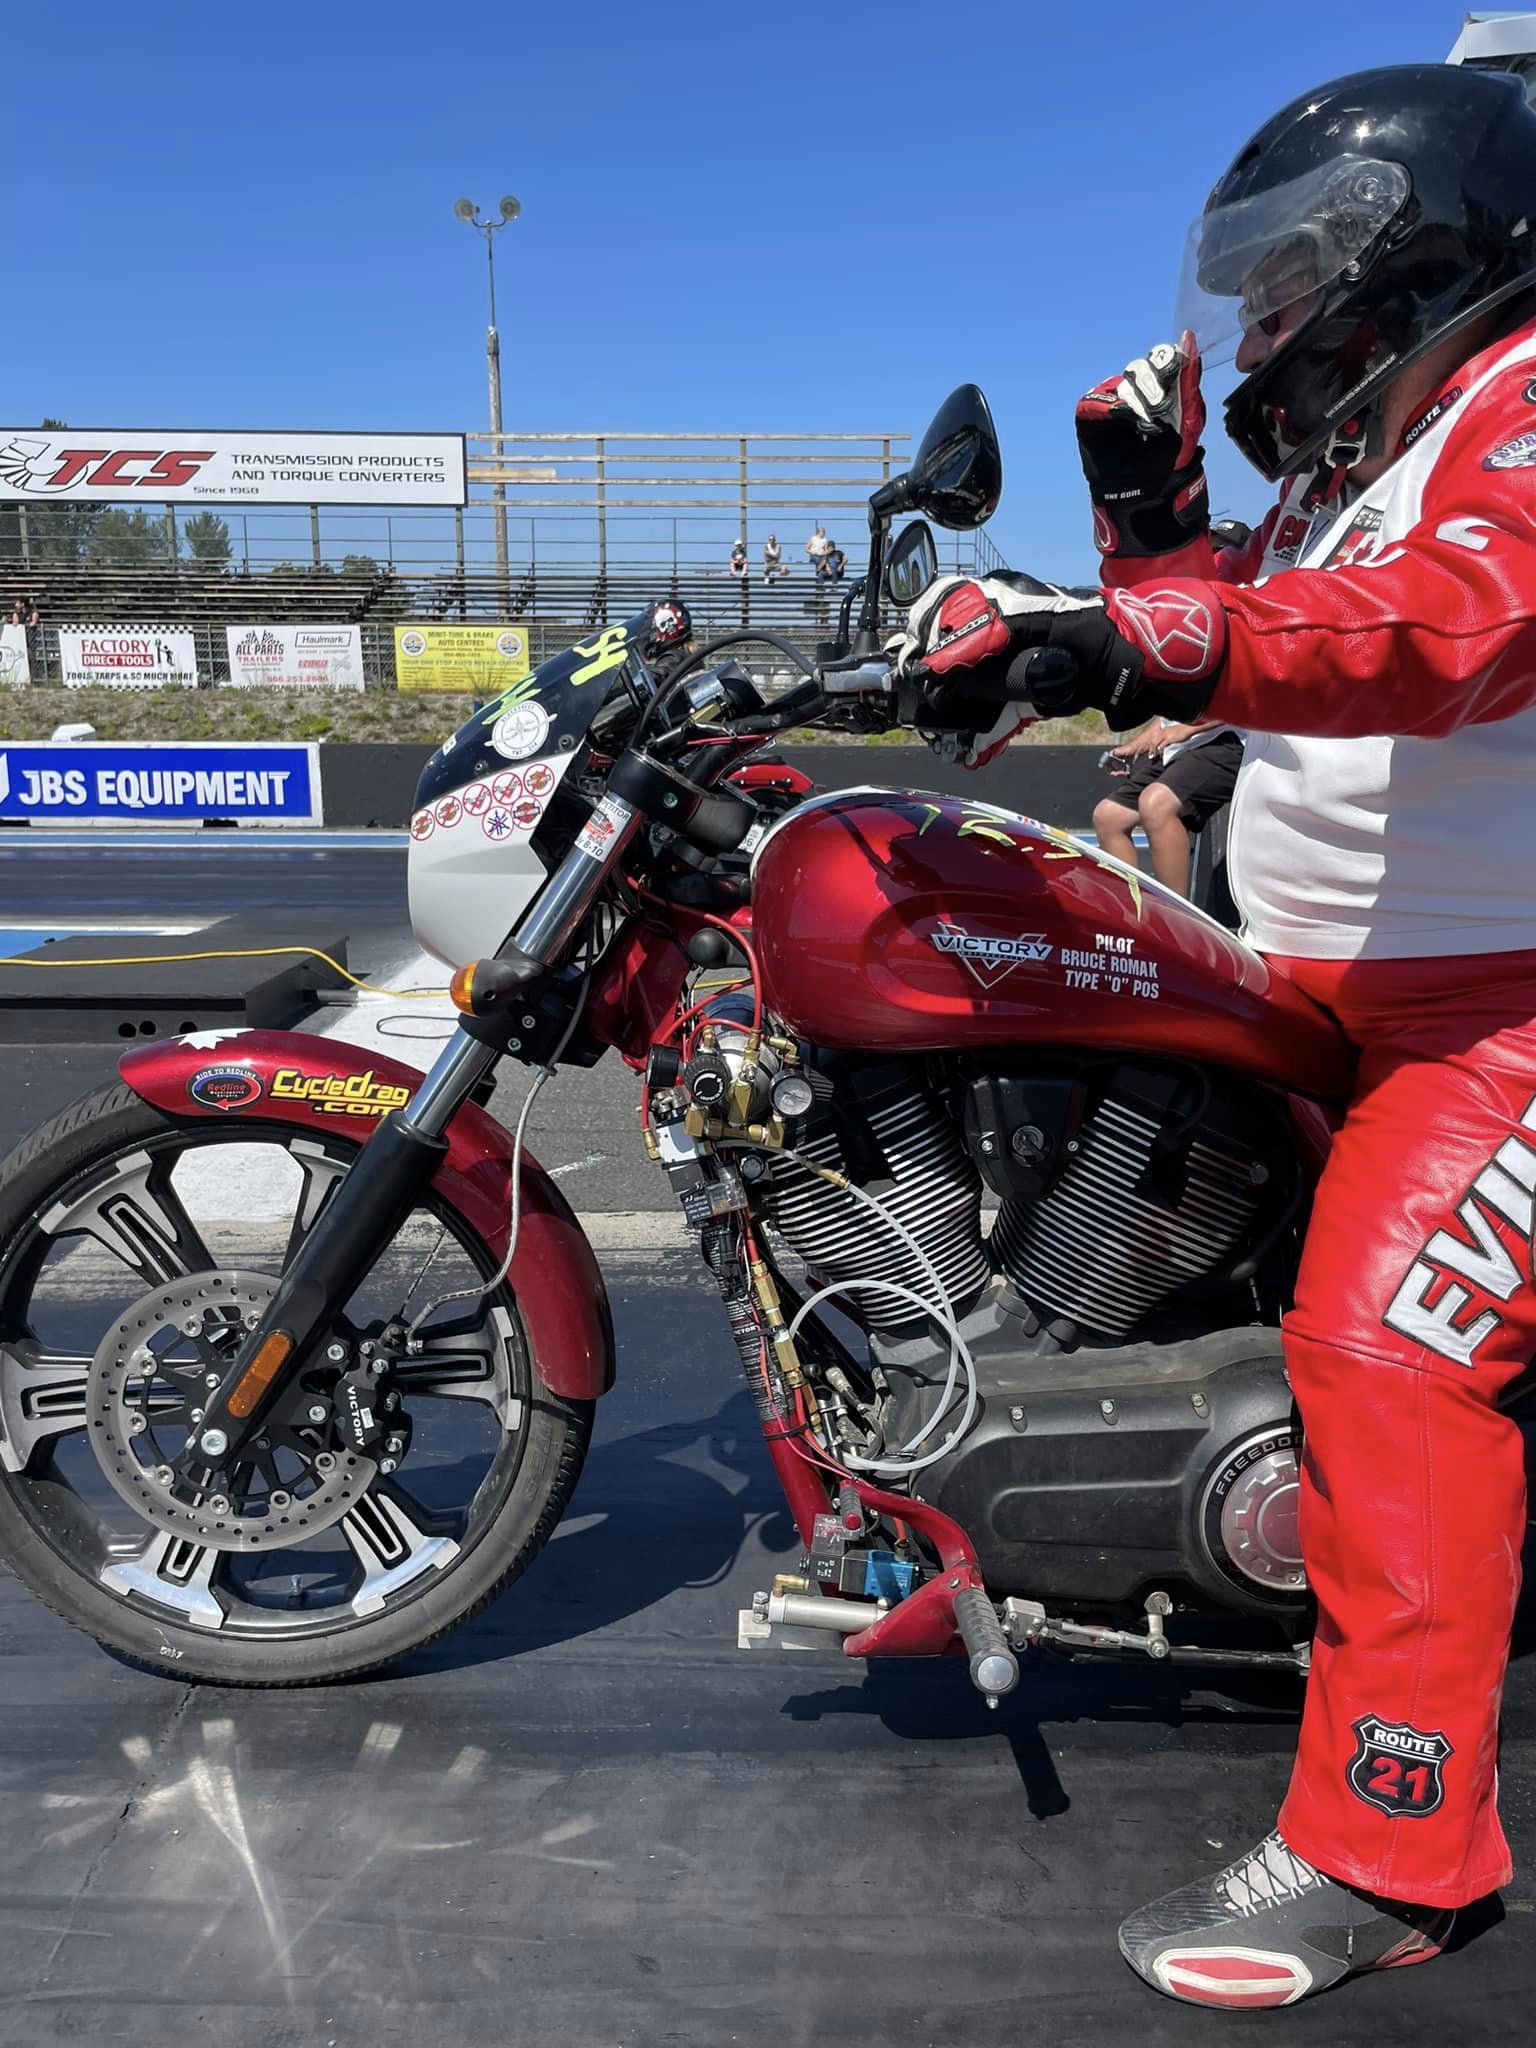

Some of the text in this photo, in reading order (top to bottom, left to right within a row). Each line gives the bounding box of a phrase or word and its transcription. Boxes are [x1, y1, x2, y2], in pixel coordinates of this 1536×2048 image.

[1405, 404, 1441, 444] ROUTE
[46, 449, 217, 487] TCS
[232, 454, 445, 468] TRANSMISSION PRODUCTS
[231, 470, 446, 483] AND TORQUE CONVERTERS
[193, 486, 226, 495] Since
[81, 639, 152, 653] FACTORY
[302, 635, 343, 644] Haulmark
[438, 639, 455, 647] AUTO
[83, 656, 153, 666] DIRECT TOOLS
[95, 672, 121, 680] TARPS
[18, 769, 291, 809] JBS EQUIPMENT
[935, 936, 1050, 959] VICTORY
[1095, 933, 1135, 955] PILOT
[1060, 949, 1159, 979] BRUCE ROMAK
[1065, 969, 1100, 991] TYPE
[1133, 981, 1160, 999] POS
[196, 1069, 212, 1080] RIDE
[226, 1067, 257, 1080] REDLINE
[207, 1082, 246, 1092] Redline
[271, 1070, 411, 1107] CycleDrag
[347, 1385, 365, 1446] VICTORY
[1373, 1728, 1437, 1755] ROUTE
[1367, 1756, 1429, 1803] 21
